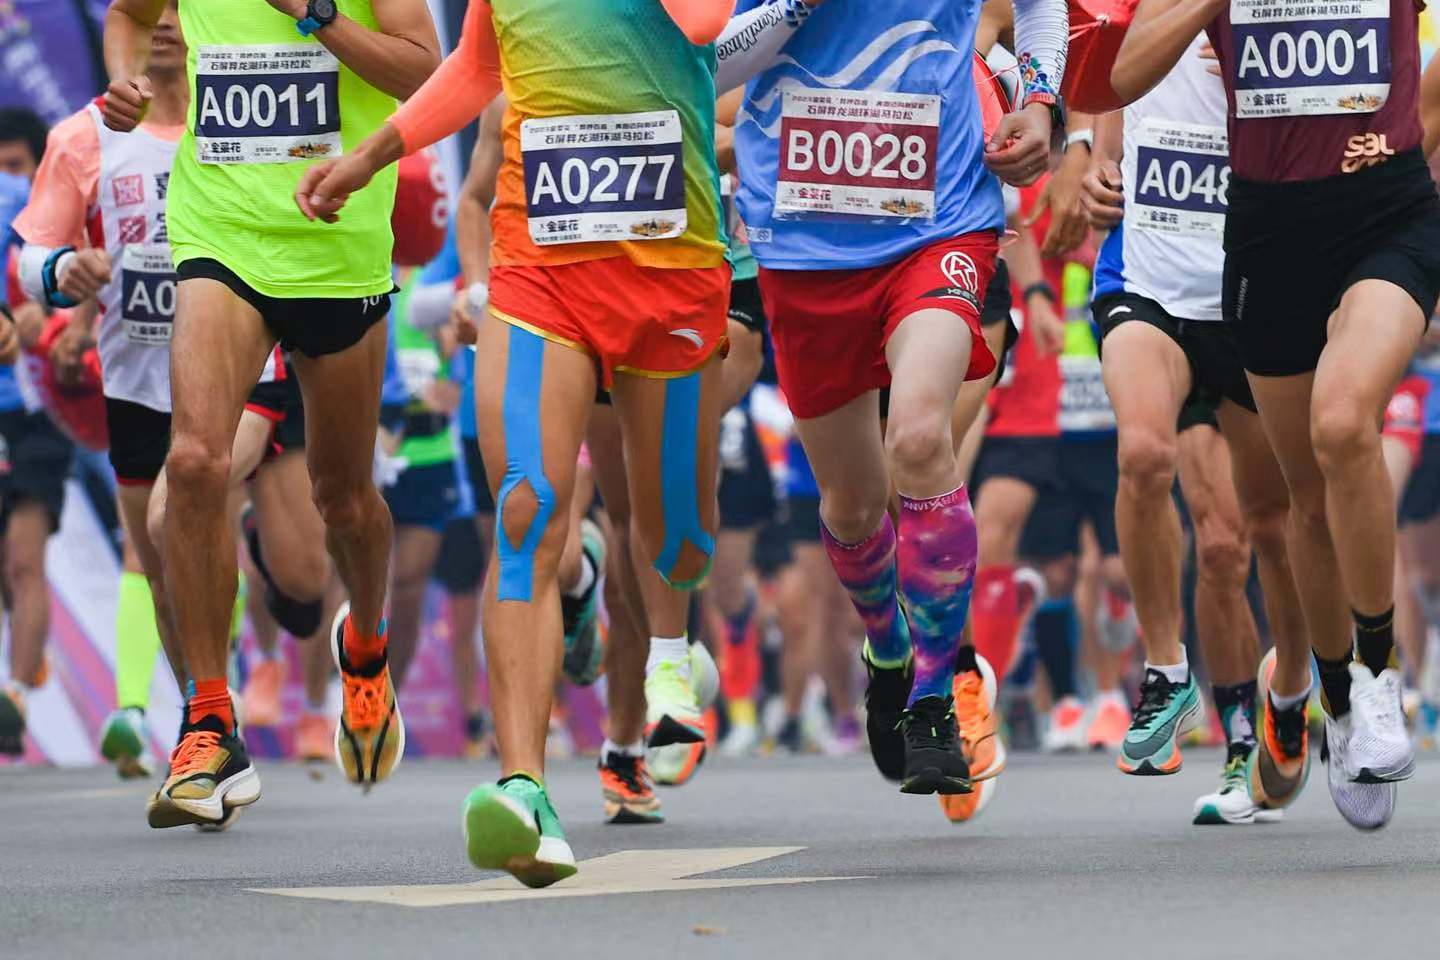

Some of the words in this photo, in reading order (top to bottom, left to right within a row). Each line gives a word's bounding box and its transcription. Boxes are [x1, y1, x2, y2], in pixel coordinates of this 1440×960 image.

[1238, 29, 1379, 79] A0001
[200, 83, 327, 128] A0011
[531, 154, 675, 205] A0277
[787, 129, 928, 181] B0028
[1139, 158, 1232, 206] A048
